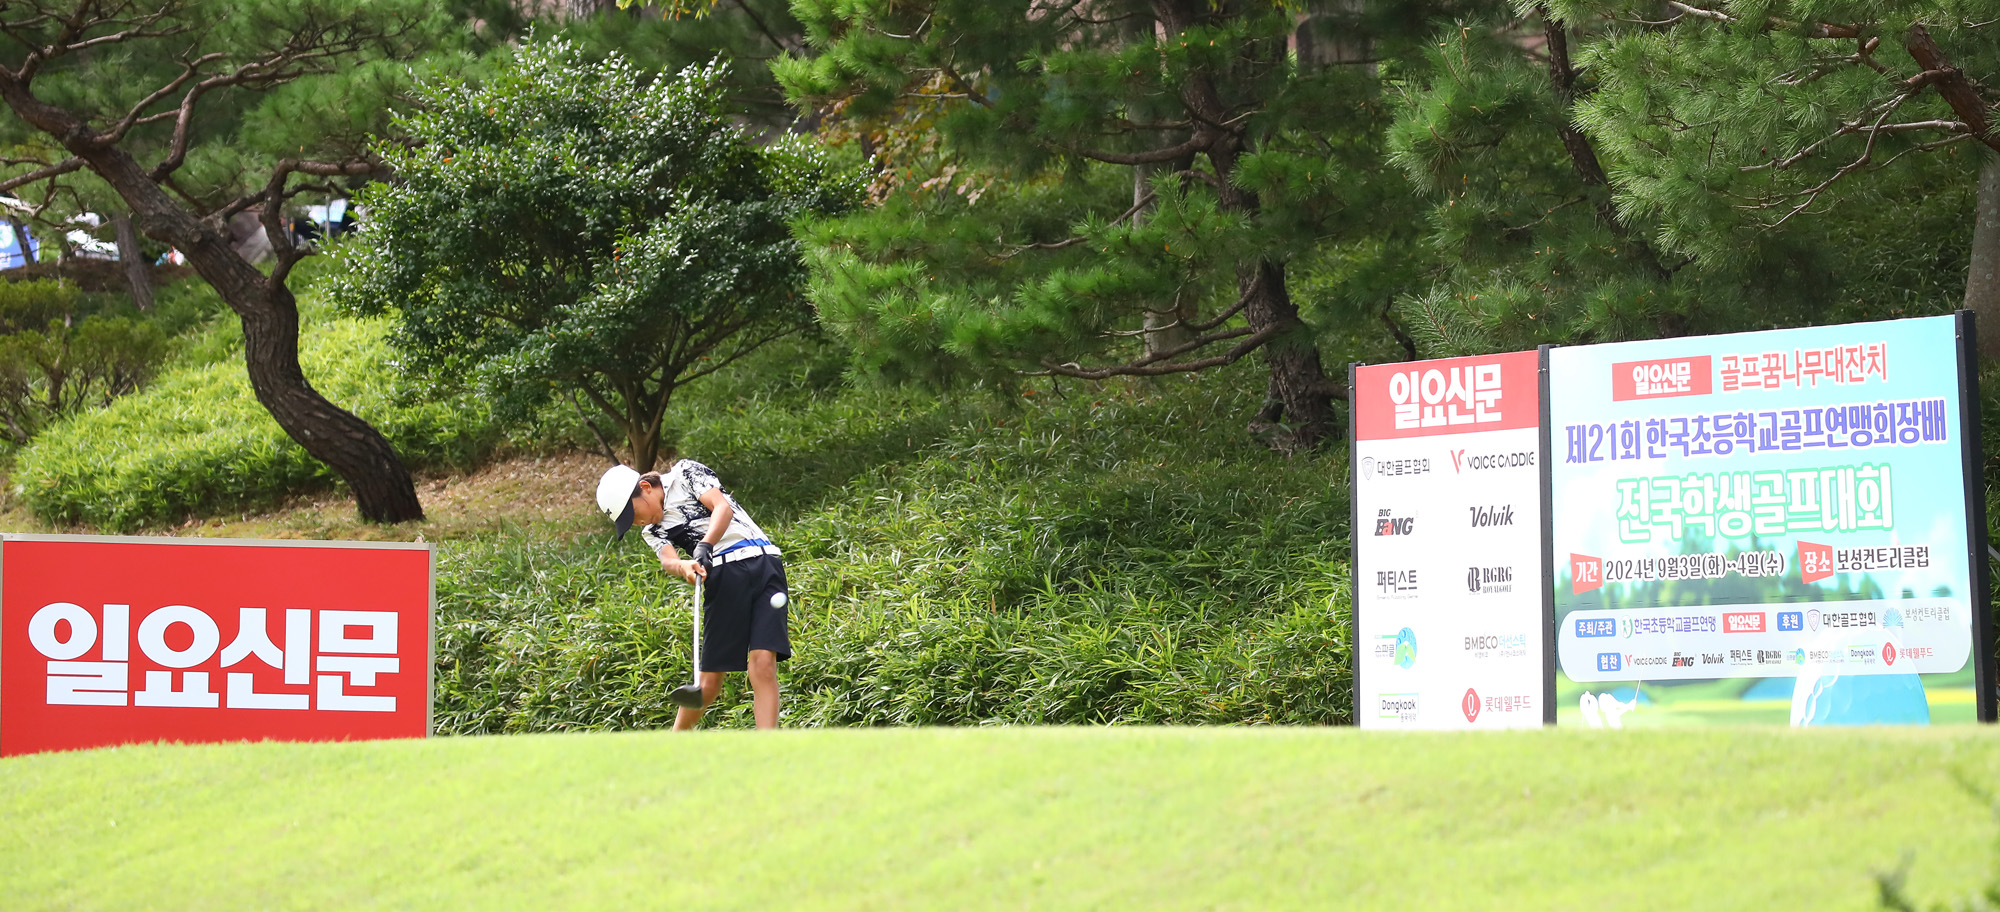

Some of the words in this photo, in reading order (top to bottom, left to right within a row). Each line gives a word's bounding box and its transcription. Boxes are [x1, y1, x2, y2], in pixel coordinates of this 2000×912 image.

[1632, 362, 1691, 395] 일요신문
[1720, 343, 1887, 391] 골프꿈나무대잔치
[1389, 363, 1503, 430] 일요신문
[1566, 420, 1641, 464] 제21회
[1645, 399, 1947, 459] 한국초등학교골프연맹회장배
[1377, 458, 1430, 477] 대한골프협회
[1467, 454, 1496, 470] VOICE
[1498, 451, 1535, 468] CADDIE
[1378, 508, 1391, 517] BIG
[1617, 462, 1894, 543] 전국학생골프대회
[1470, 504, 1514, 527] Volvik
[1575, 560, 1599, 583] 기간
[1605, 558, 1654, 581] 2024년
[1804, 550, 1831, 574] 장소
[1837, 546, 1929, 571] 보성컨트리클럽
[1376, 569, 1418, 594] 퍼티스트
[1482, 566, 1513, 584] RGRG
[1578, 620, 1614, 636] 주최/주관
[1634, 615, 1717, 634] 한국초등학교골프연맹
[1728, 614, 1761, 631] 일요신문
[1782, 614, 1799, 629] 후원
[1822, 611, 1877, 628] 대한골프협회
[1904, 606, 1950, 622] 보성컨트리클럽
[28, 602, 400, 712] 일요신문
[1375, 644, 1395, 658] 스파클
[1701, 653, 1725, 665] Volvik
[1730, 649, 1753, 663] 퍼티스트
[1600, 655, 1618, 670] 협찬
[1382, 699, 1417, 714] Dongkook
[1485, 695, 1532, 713] 롯데웰푸드
